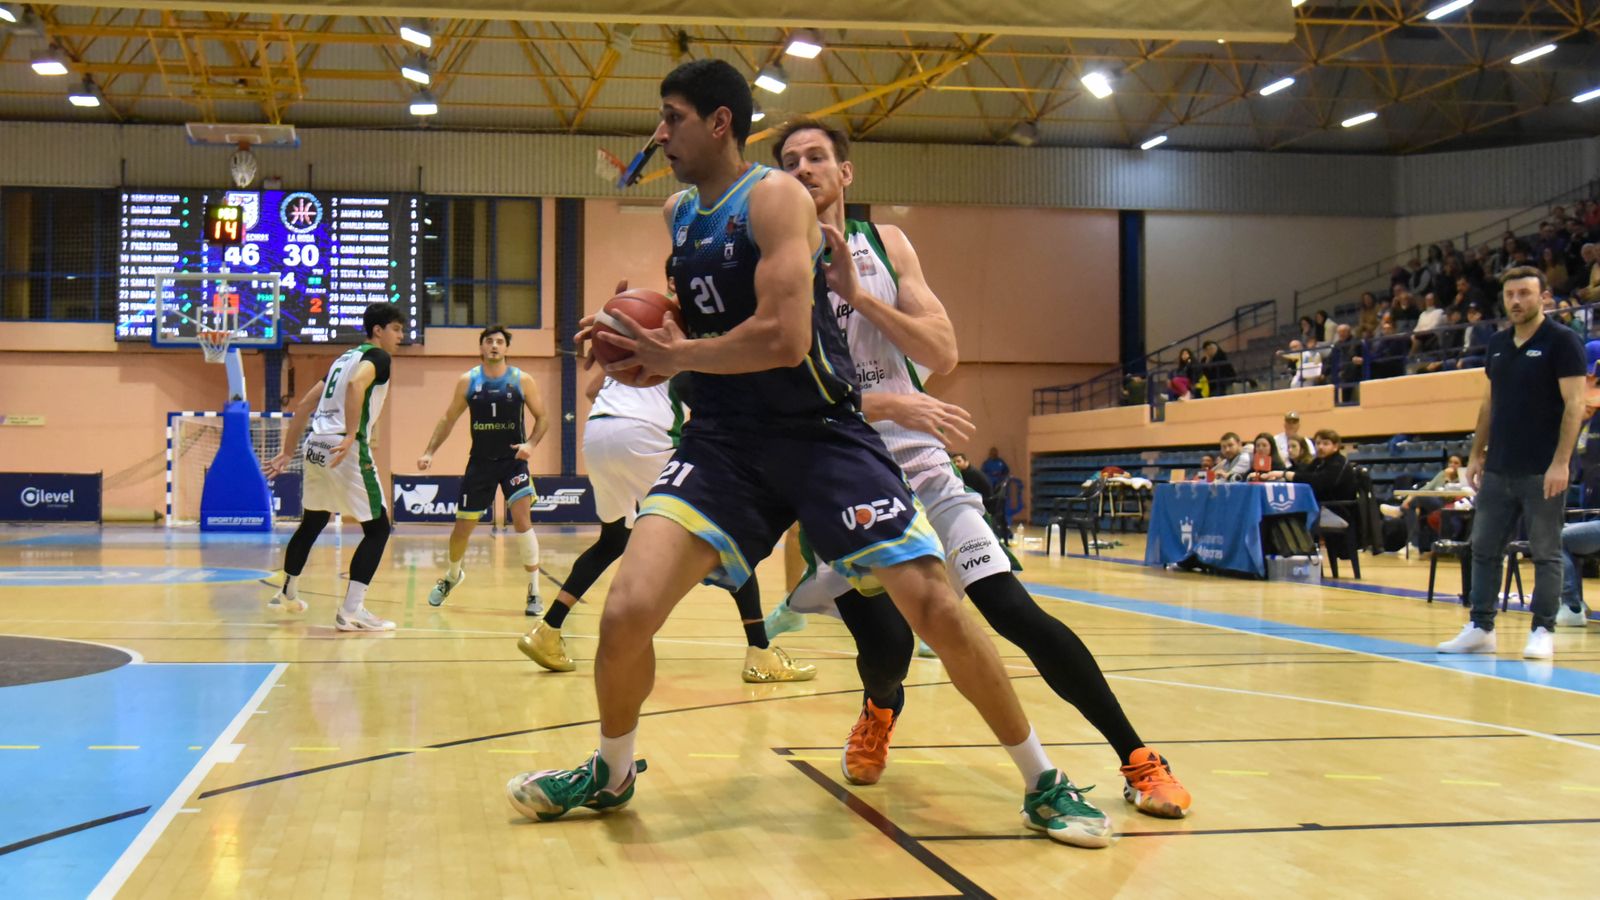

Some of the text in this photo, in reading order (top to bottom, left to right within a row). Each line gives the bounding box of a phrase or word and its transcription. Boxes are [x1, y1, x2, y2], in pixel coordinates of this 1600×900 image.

[331, 198, 338, 207] 2
[411, 199, 417, 208] 2
[214, 221, 237, 240] 14
[332, 222, 338, 230] 4
[287, 234, 296, 242] LA
[411, 236, 417, 244] 3
[122, 242, 128, 251] 7
[224, 244, 260, 266] 46
[283, 244, 320, 267] 30
[120, 266, 130, 275] 14
[119, 291, 130, 299] 22
[690, 276, 726, 314] 21
[309, 298, 323, 313] 2
[325, 368, 342, 399] 6
[490, 402, 497, 417] 1
[473, 420, 517, 432] damex.io
[305, 448, 326, 466] Ruiz
[654, 461, 694, 488] 21
[462, 494, 468, 508] 1
[841, 497, 907, 531] UDEA
[961, 554, 991, 571] vive
